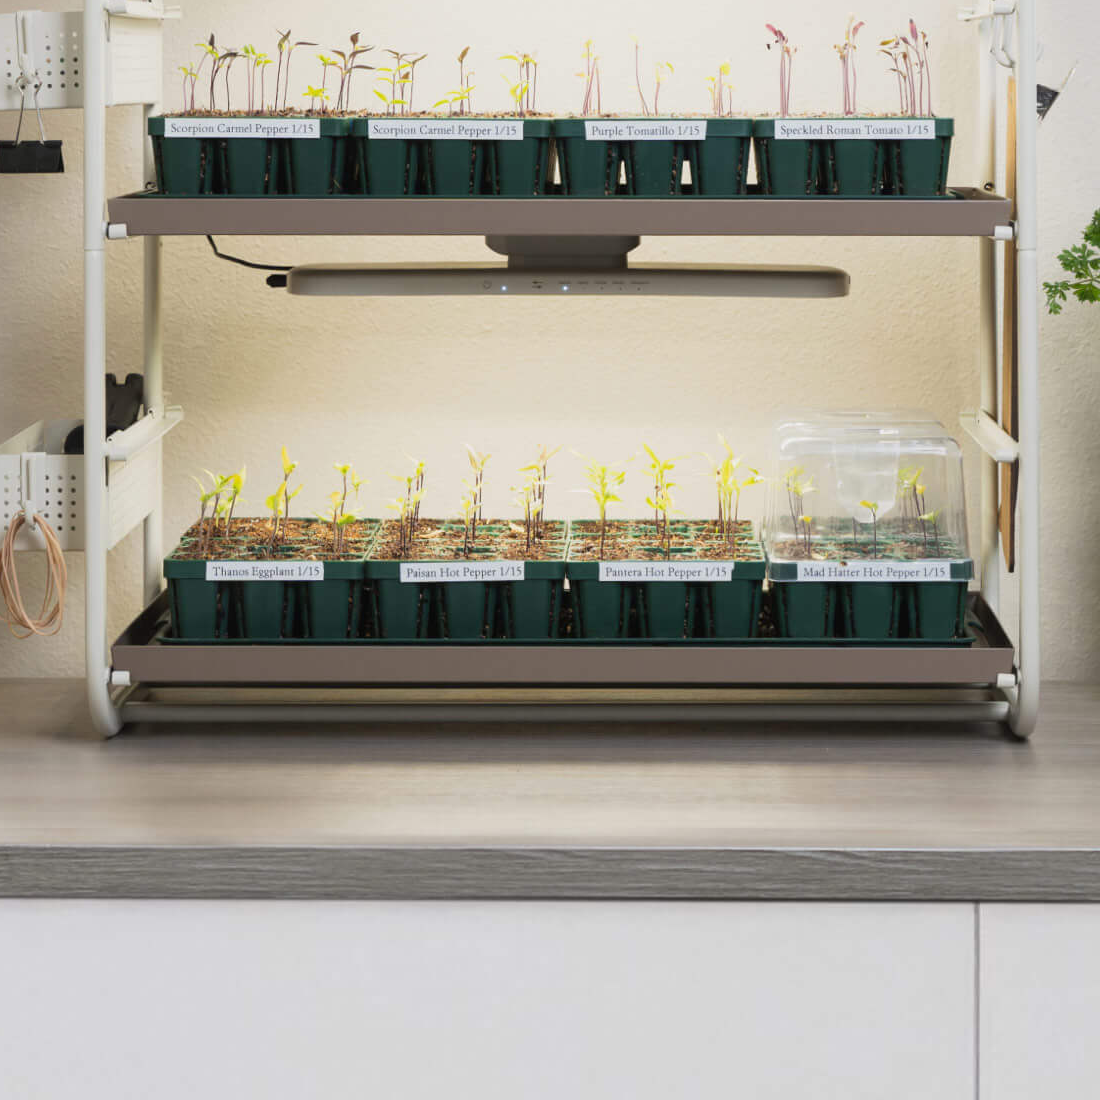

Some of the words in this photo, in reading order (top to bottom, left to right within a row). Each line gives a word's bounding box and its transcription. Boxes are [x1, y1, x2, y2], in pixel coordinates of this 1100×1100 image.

[171, 123, 215, 136] Scorpion
[217, 123, 252, 133] Carmel
[255, 124, 288, 136] Pepper
[291, 123, 314, 134] 1/15
[373, 124, 416, 136] Scorpion
[419, 124, 454, 135] Carmel
[457, 125, 491, 137] Pepper
[494, 125, 517, 136] 1/15
[591, 125, 623, 137] Purple
[626, 125, 675, 136] Tomatillo
[678, 125, 700, 135] 1/15
[780, 124, 823, 137] Speckled
[826, 125, 861, 135] Roman
[864, 125, 903, 135] Tomato
[906, 124, 929, 135] 1/15
[212, 566, 249, 577] Thanos
[252, 566, 294, 578] Eggplant
[297, 566, 320, 577] 1/15
[406, 568, 437, 578] Paisan
[440, 567, 459, 578] Hot
[463, 567, 496, 579] Pepper
[499, 566, 522, 577] 1/15
[605, 567, 642, 577] Pantera
[645, 567, 665, 577] Hot
[668, 567, 702, 579] Pepper
[705, 566, 727, 577] 1/15
[803, 567, 825, 577] Mad
[828, 567, 860, 577] Hatter
[863, 567, 883, 577] Hot
[886, 567, 920, 579] Pepper
[923, 567, 946, 577] 1/15
